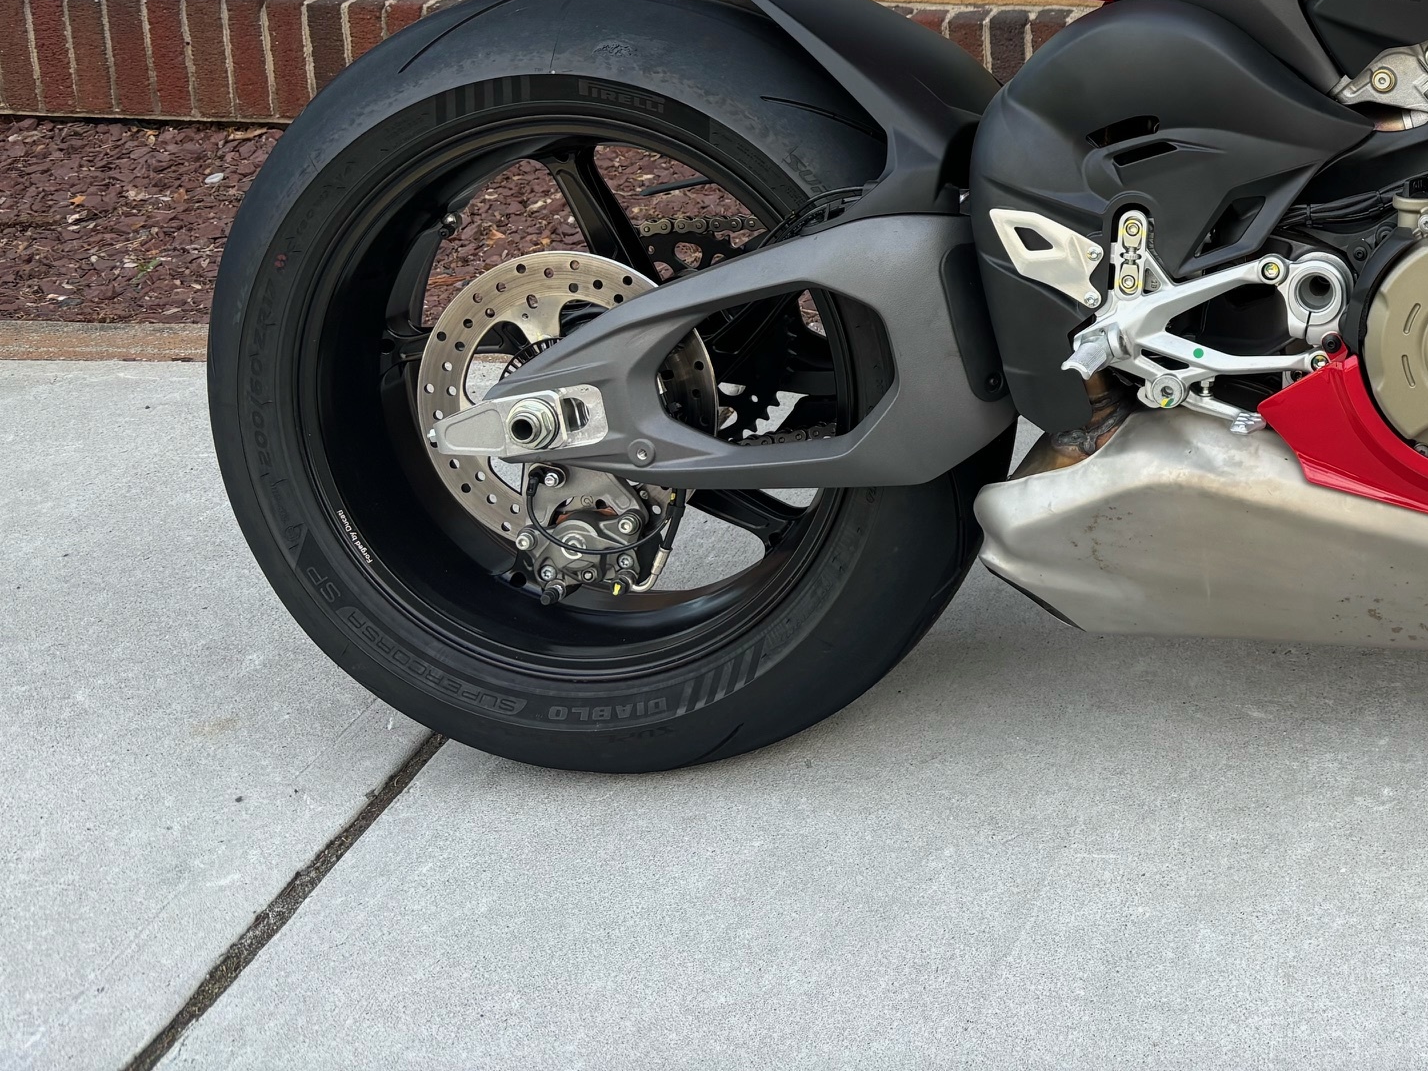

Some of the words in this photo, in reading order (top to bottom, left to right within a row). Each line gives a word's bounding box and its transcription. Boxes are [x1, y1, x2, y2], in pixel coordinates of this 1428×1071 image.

[577, 77, 665, 114] PIRELLI
[336, 509, 353, 534] Ducati
[349, 530, 361, 543] by
[354, 540, 373, 566] Forged
[306, 566, 342, 604] SP
[346, 610, 519, 714] SUPERCORSA
[547, 696, 667, 722] DIABLO
